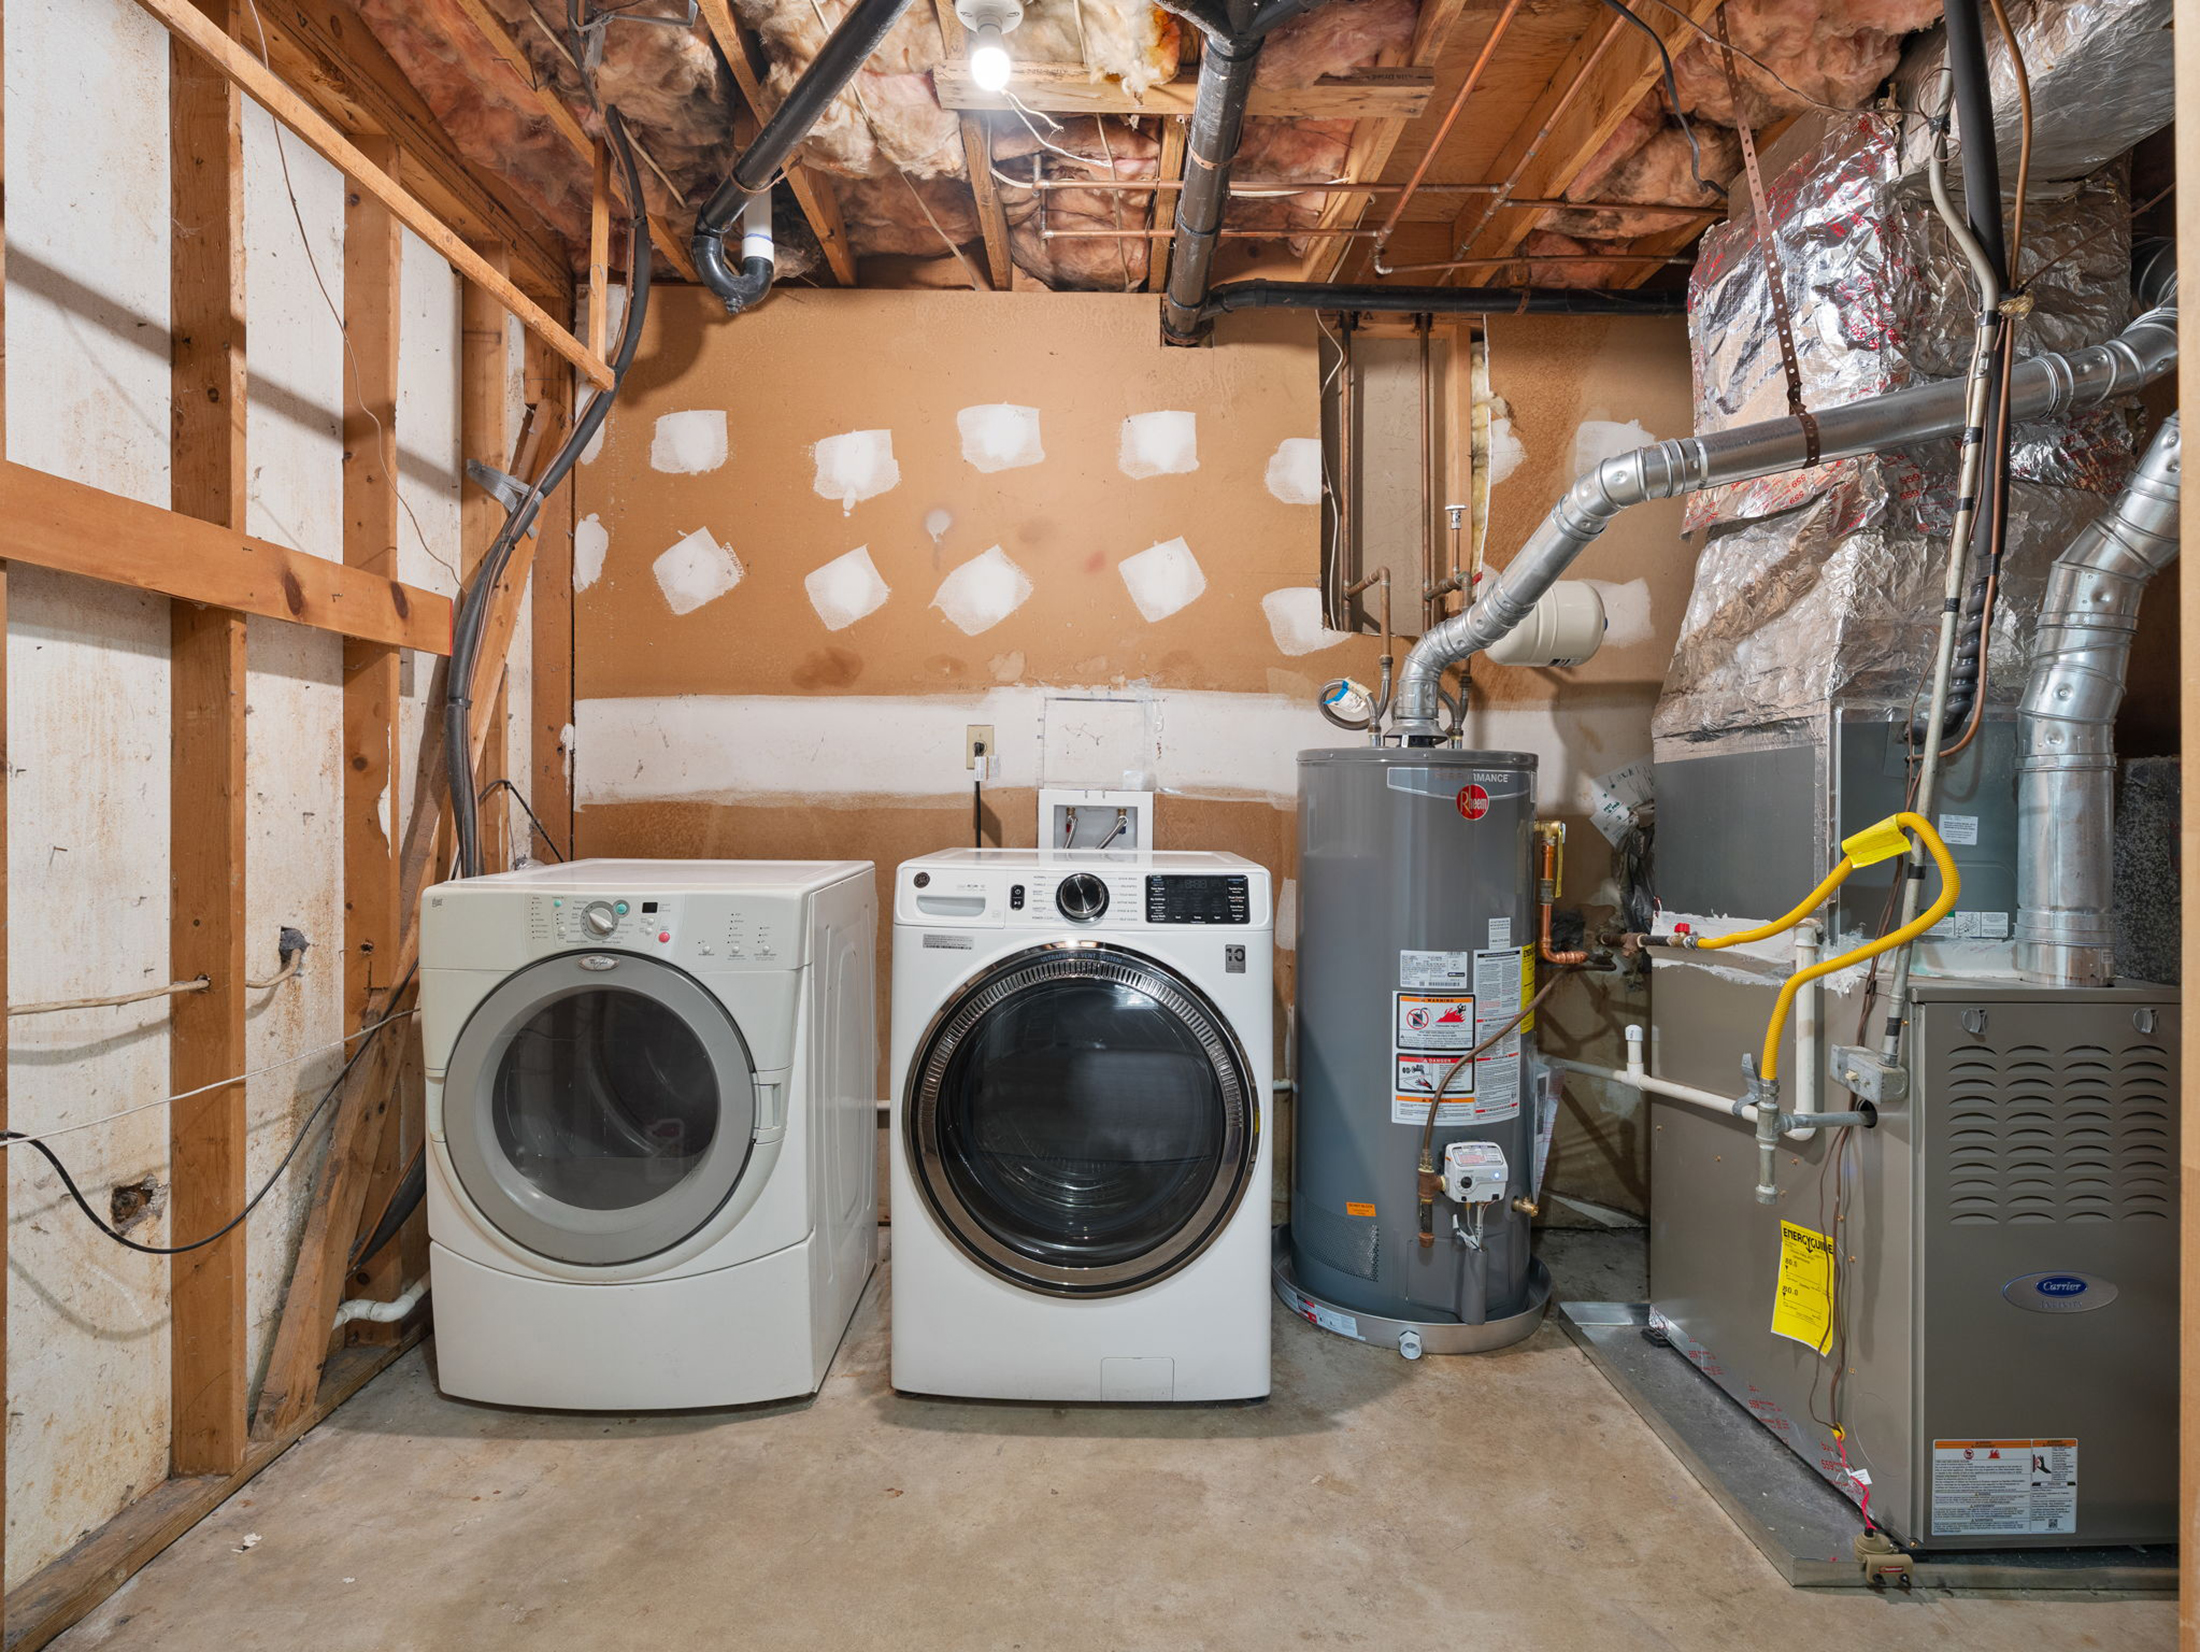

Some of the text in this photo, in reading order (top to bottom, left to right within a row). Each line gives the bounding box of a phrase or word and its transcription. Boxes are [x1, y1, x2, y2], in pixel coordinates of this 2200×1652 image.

[1460, 784, 1487, 815] Rheem
[1041, 952, 1123, 964] ULTRAFRESH VENT SYSTEM
[2042, 1281, 2082, 1291] Carrier
